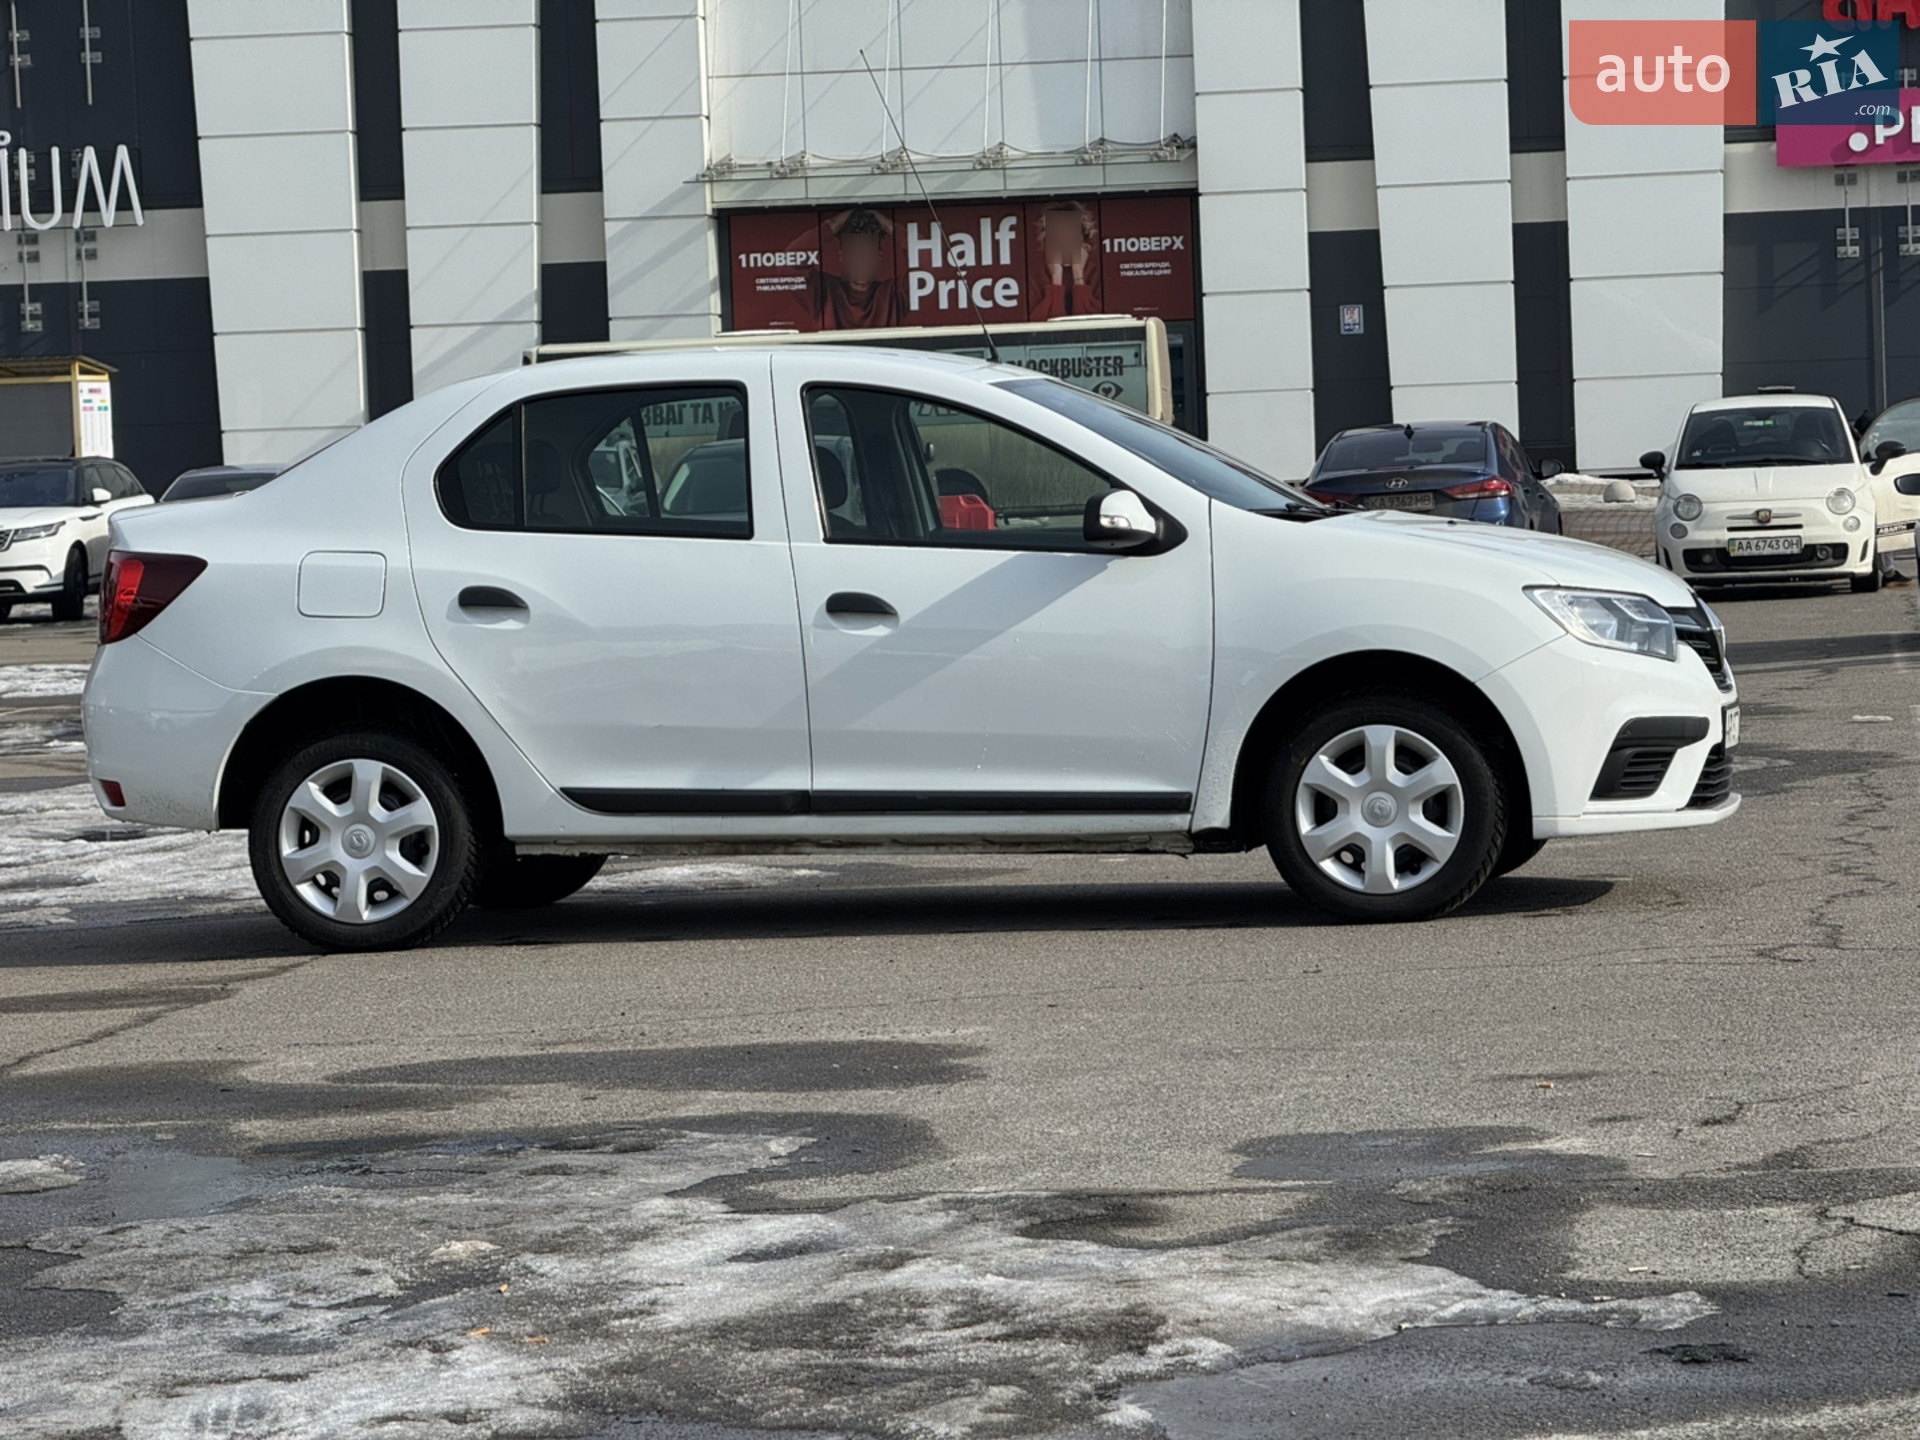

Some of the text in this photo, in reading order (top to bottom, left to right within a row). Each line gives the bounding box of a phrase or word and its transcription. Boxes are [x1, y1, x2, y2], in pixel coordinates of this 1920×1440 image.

[907, 215, 1018, 268] Half
[1113, 235, 1185, 253] ПОВЕРХ
[749, 250, 820, 268] ПОВЕРХ
[908, 270, 1020, 311] Price
[1755, 539, 1780, 551] 6743
